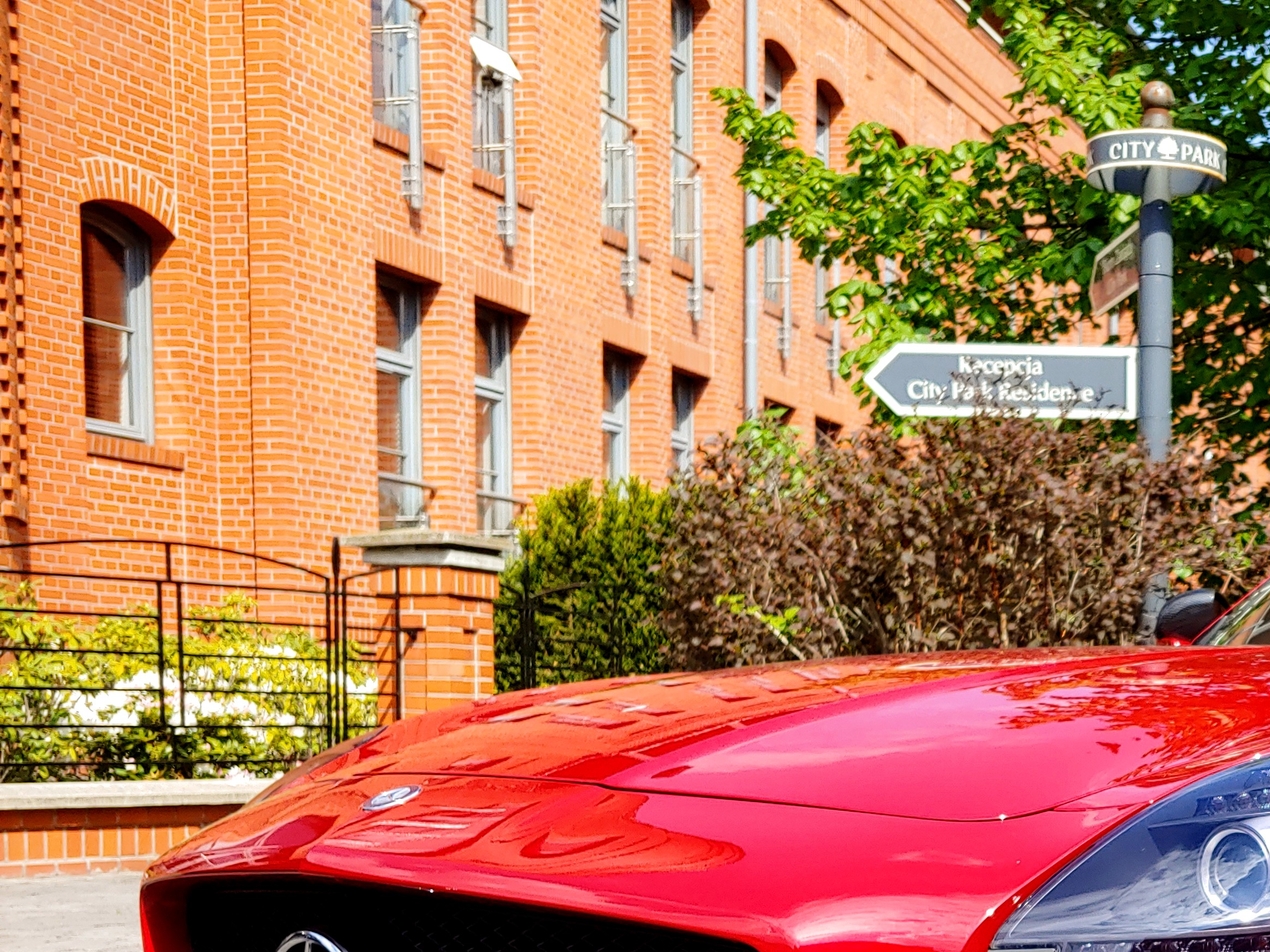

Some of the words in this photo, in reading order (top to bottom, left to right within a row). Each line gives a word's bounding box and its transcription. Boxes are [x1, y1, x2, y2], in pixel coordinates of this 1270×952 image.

[1109, 140, 1155, 160] CITY
[1181, 142, 1221, 169] PARK
[907, 379, 948, 405] City
[951, 381, 993, 401] Pak
